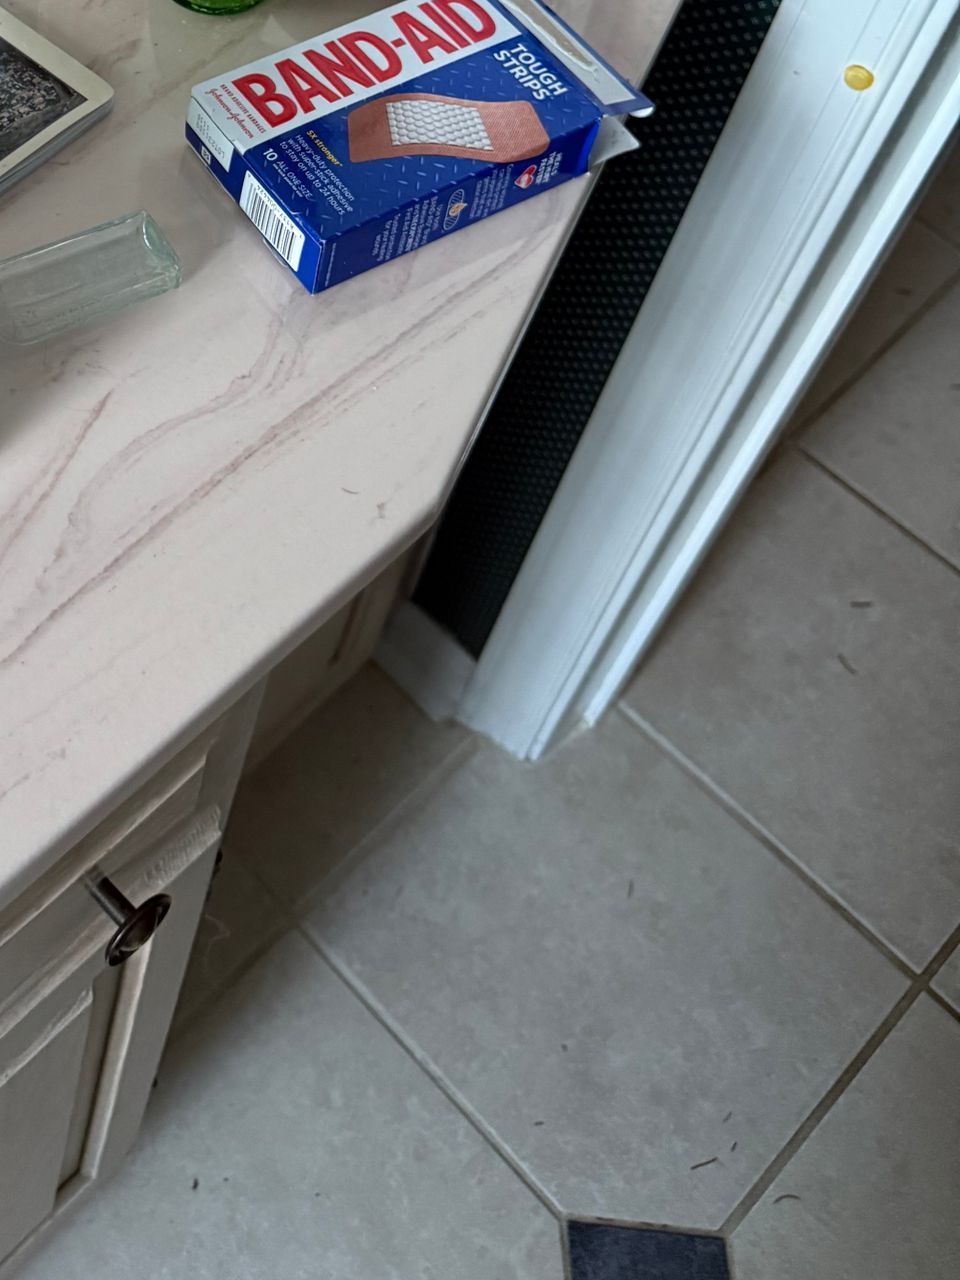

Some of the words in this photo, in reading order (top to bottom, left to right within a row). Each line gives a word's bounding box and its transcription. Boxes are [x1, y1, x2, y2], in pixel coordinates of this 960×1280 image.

[493, 49, 551, 102] STRIPS
[509, 42, 569, 95] TOUGH
[262, 147, 278, 162] 10
[306, 129, 317, 142] 5X
[276, 160, 290, 174] ALL
[287, 170, 302, 187] ONE
[298, 183, 313, 200] SIZE
[280, 141, 288, 151] to
[286, 148, 301, 167] stay
[297, 162, 307, 173] on
[305, 171, 315, 183] up
[313, 180, 321, 190] to
[319, 187, 329, 199] 24
[326, 195, 346, 216] hours
[286, 139, 302, 157] with
[298, 151, 330, 187] super-stick
[327, 183, 354, 213] adhesive
[295, 134, 327, 173] Heavy-duty
[325, 168, 355, 202] protection
